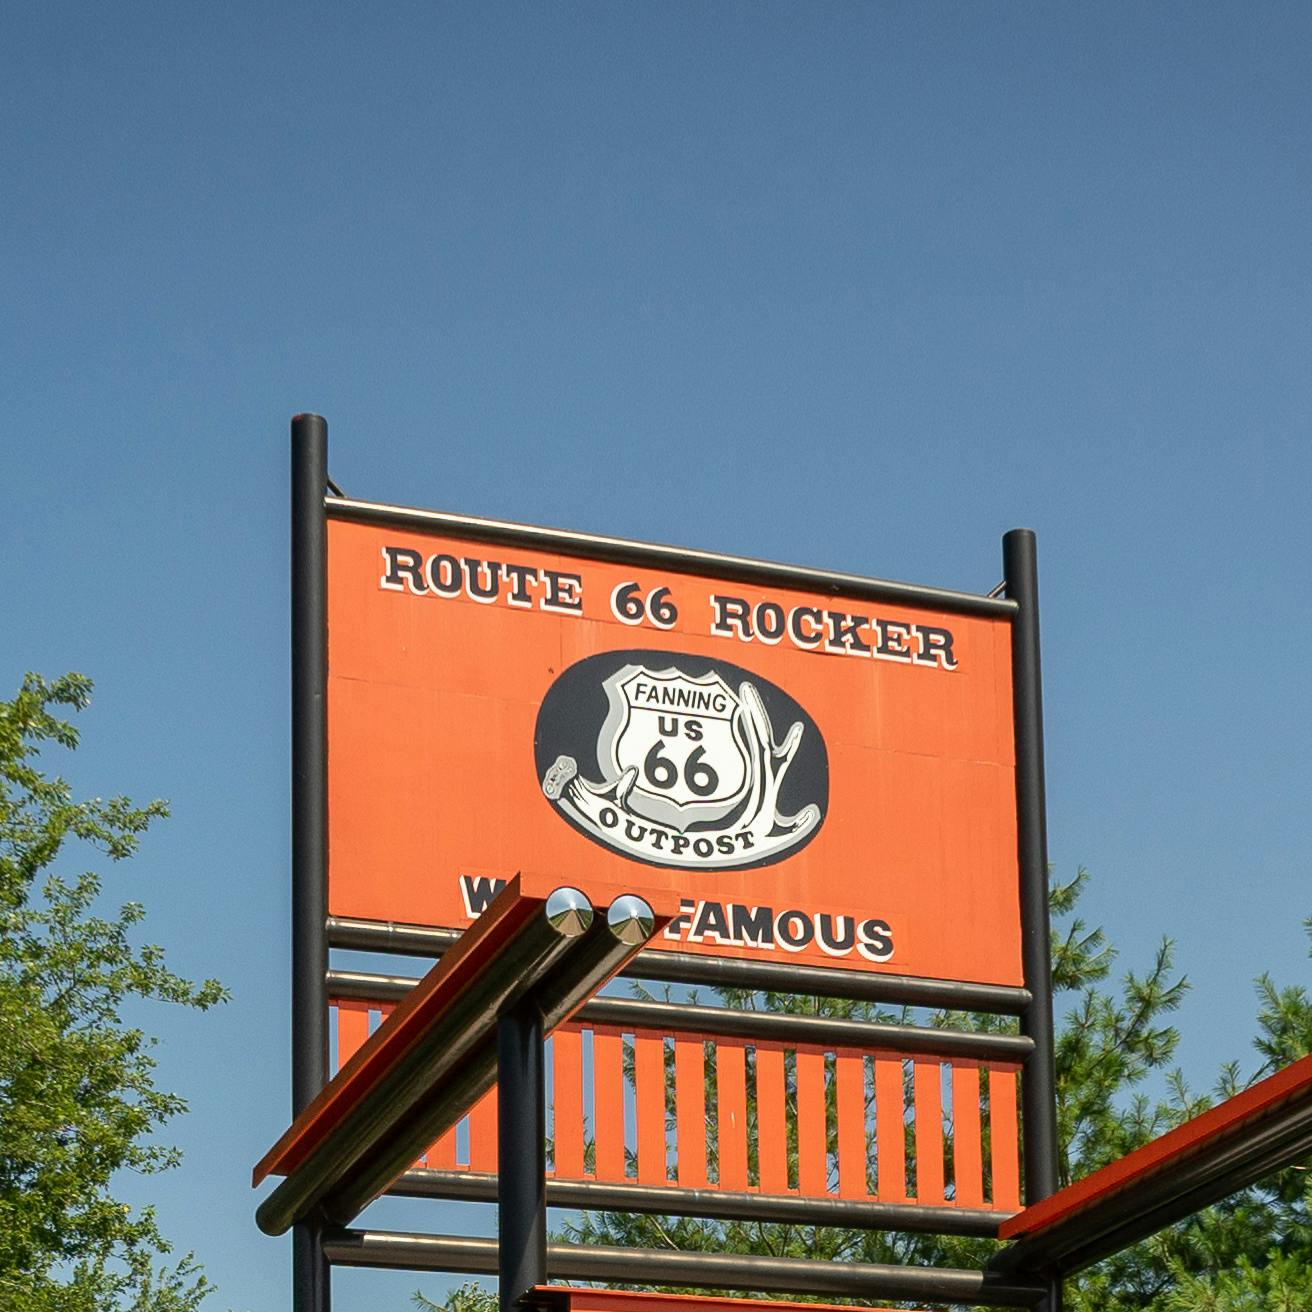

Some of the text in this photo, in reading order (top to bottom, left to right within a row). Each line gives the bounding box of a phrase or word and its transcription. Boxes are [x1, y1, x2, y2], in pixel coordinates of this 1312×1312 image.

[380, 546, 958, 671] ROUTE 66 ROCKER
[634, 682, 727, 713] FANNING
[657, 715, 704, 742] US
[643, 739, 720, 797] 66
[598, 807, 755, 858] OUTPOST
